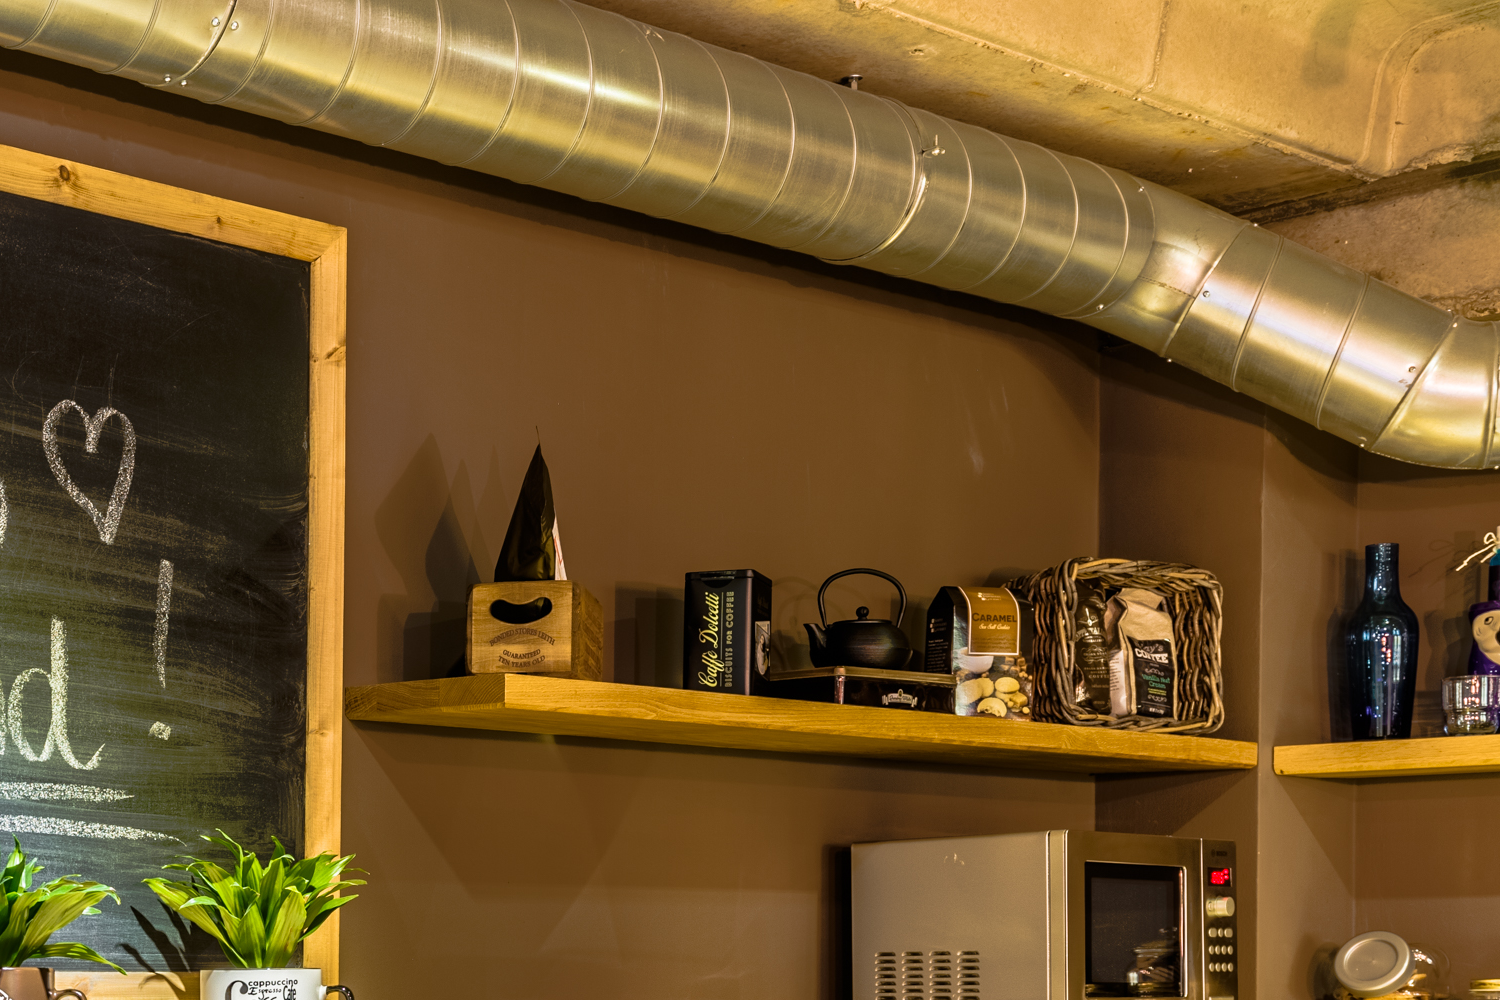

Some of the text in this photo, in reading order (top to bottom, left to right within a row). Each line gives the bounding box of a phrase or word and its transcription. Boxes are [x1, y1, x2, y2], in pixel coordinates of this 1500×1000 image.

[725, 591, 734, 628] COFFEE
[698, 591, 719, 649] Dolcetti
[972, 612, 1017, 623] CARAMEL
[489, 627, 556, 647] BONDED STORES LEITH
[502, 648, 541, 659] GUARANTEED
[498, 655, 510, 666] TEN
[532, 655, 545, 665] OLD
[724, 647, 733, 687] BISCUITS
[248, 978, 298, 989] cappuccino
[248, 987, 282, 1000] Espresso
